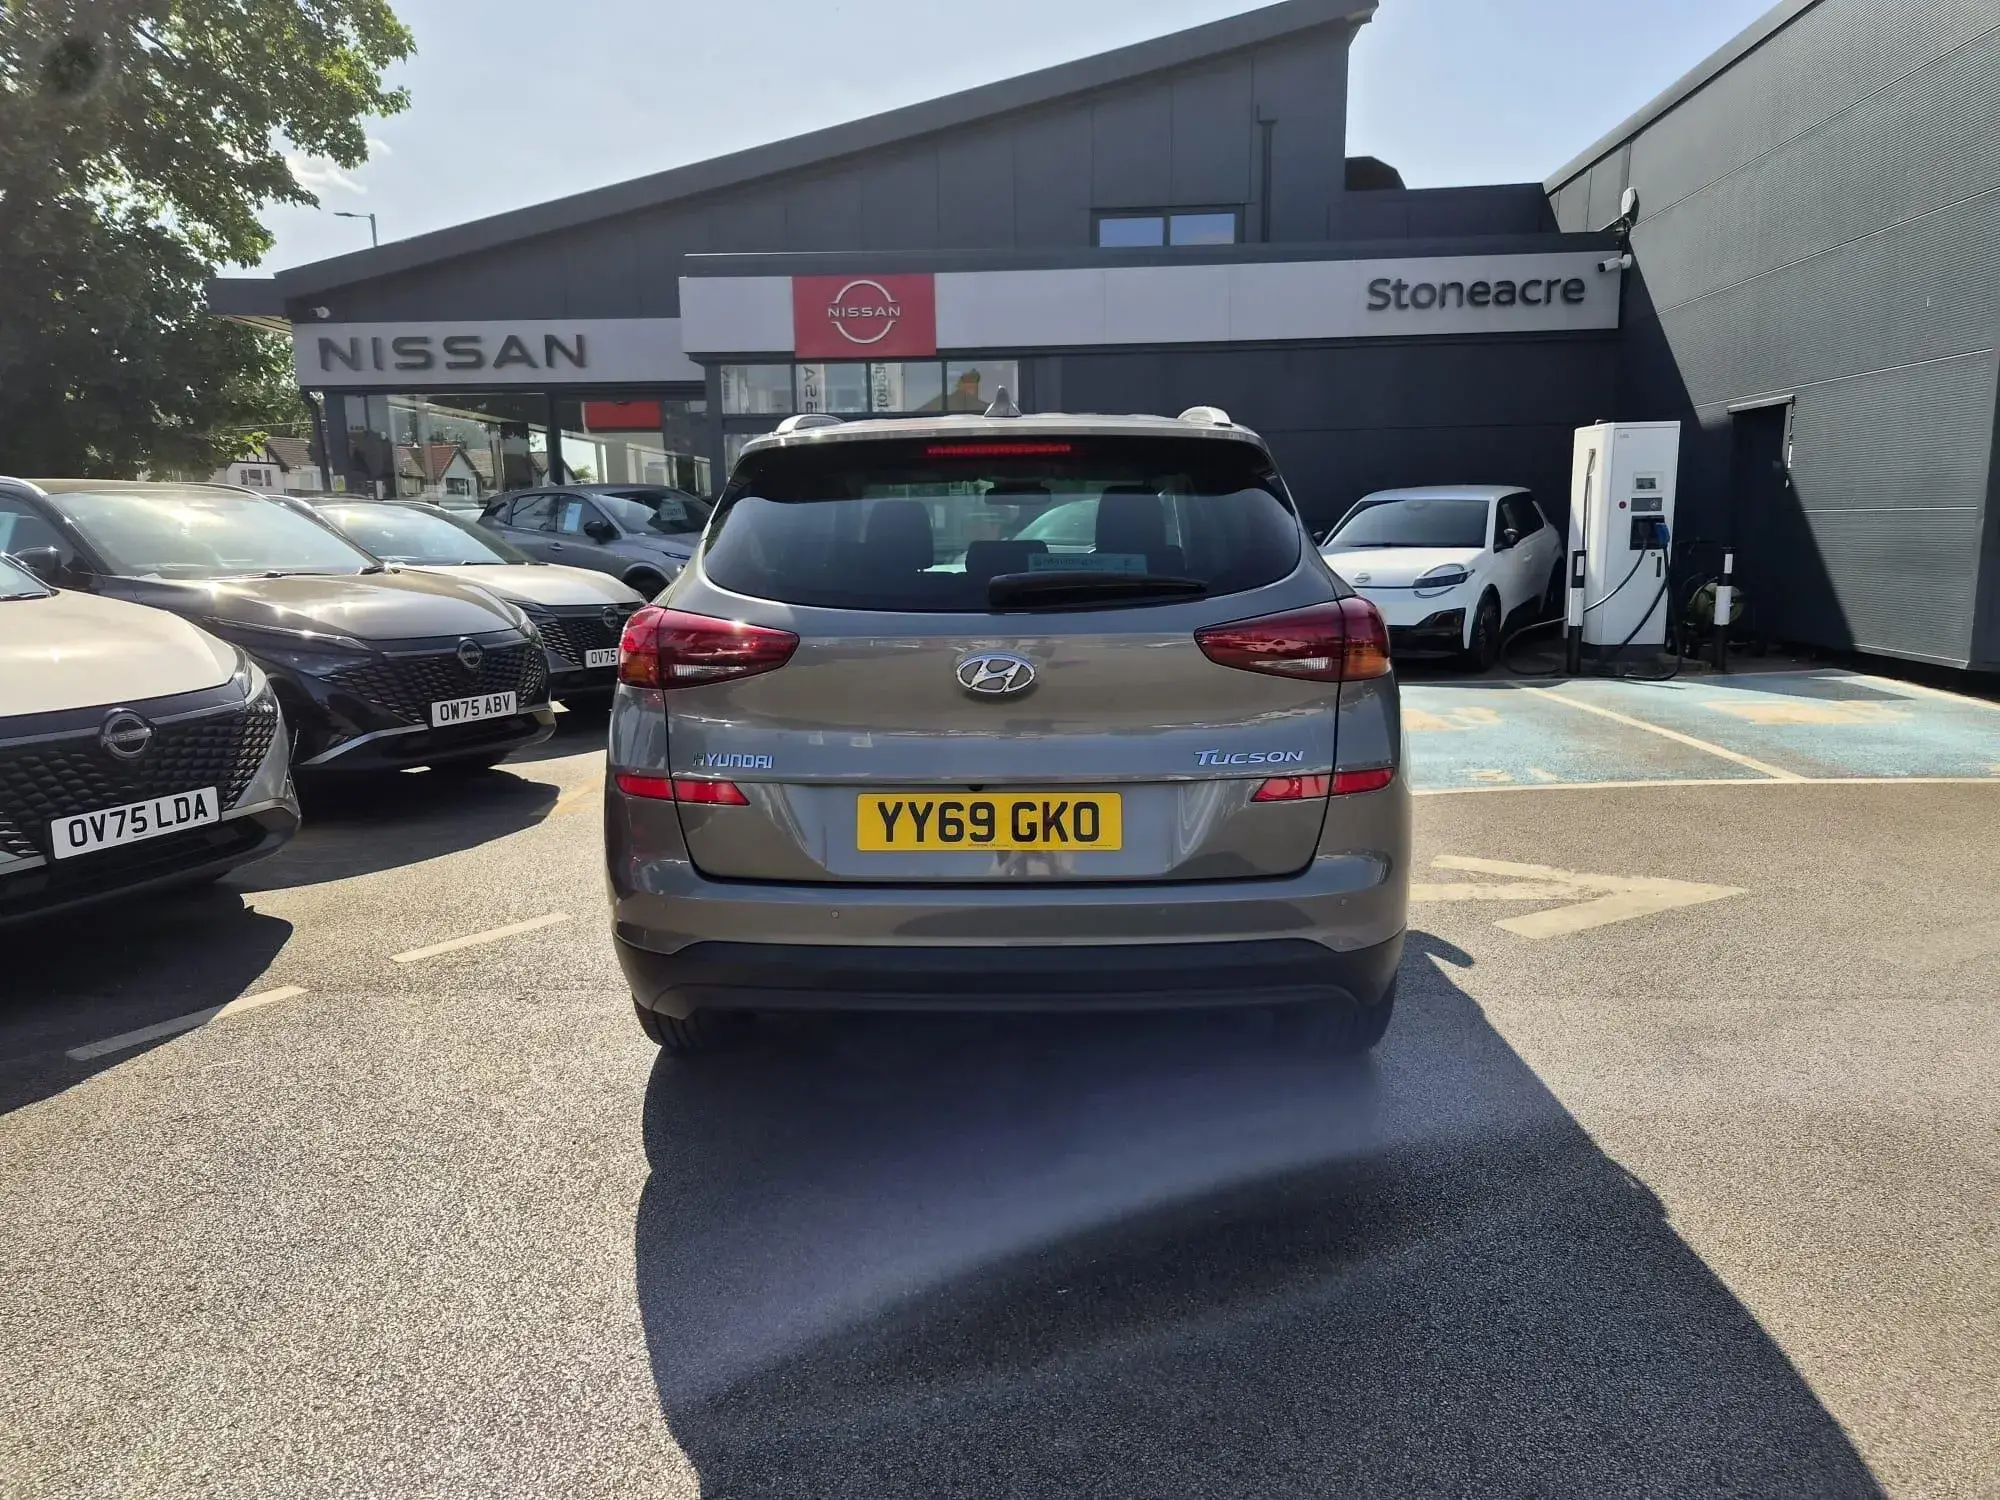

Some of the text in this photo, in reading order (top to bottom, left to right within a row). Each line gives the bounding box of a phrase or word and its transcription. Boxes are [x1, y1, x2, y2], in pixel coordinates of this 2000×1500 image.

[1367, 277, 1586, 311] Stoneacre
[827, 306, 901, 318] NISSAN
[318, 334, 588, 372] NISSAN
[591, 650, 617, 664] OV75
[440, 694, 510, 721] OW75 ABV
[692, 752, 774, 769] HYUNDAI
[68, 793, 208, 848] OV75 LDA
[877, 801, 1100, 843] YY69 GKO
